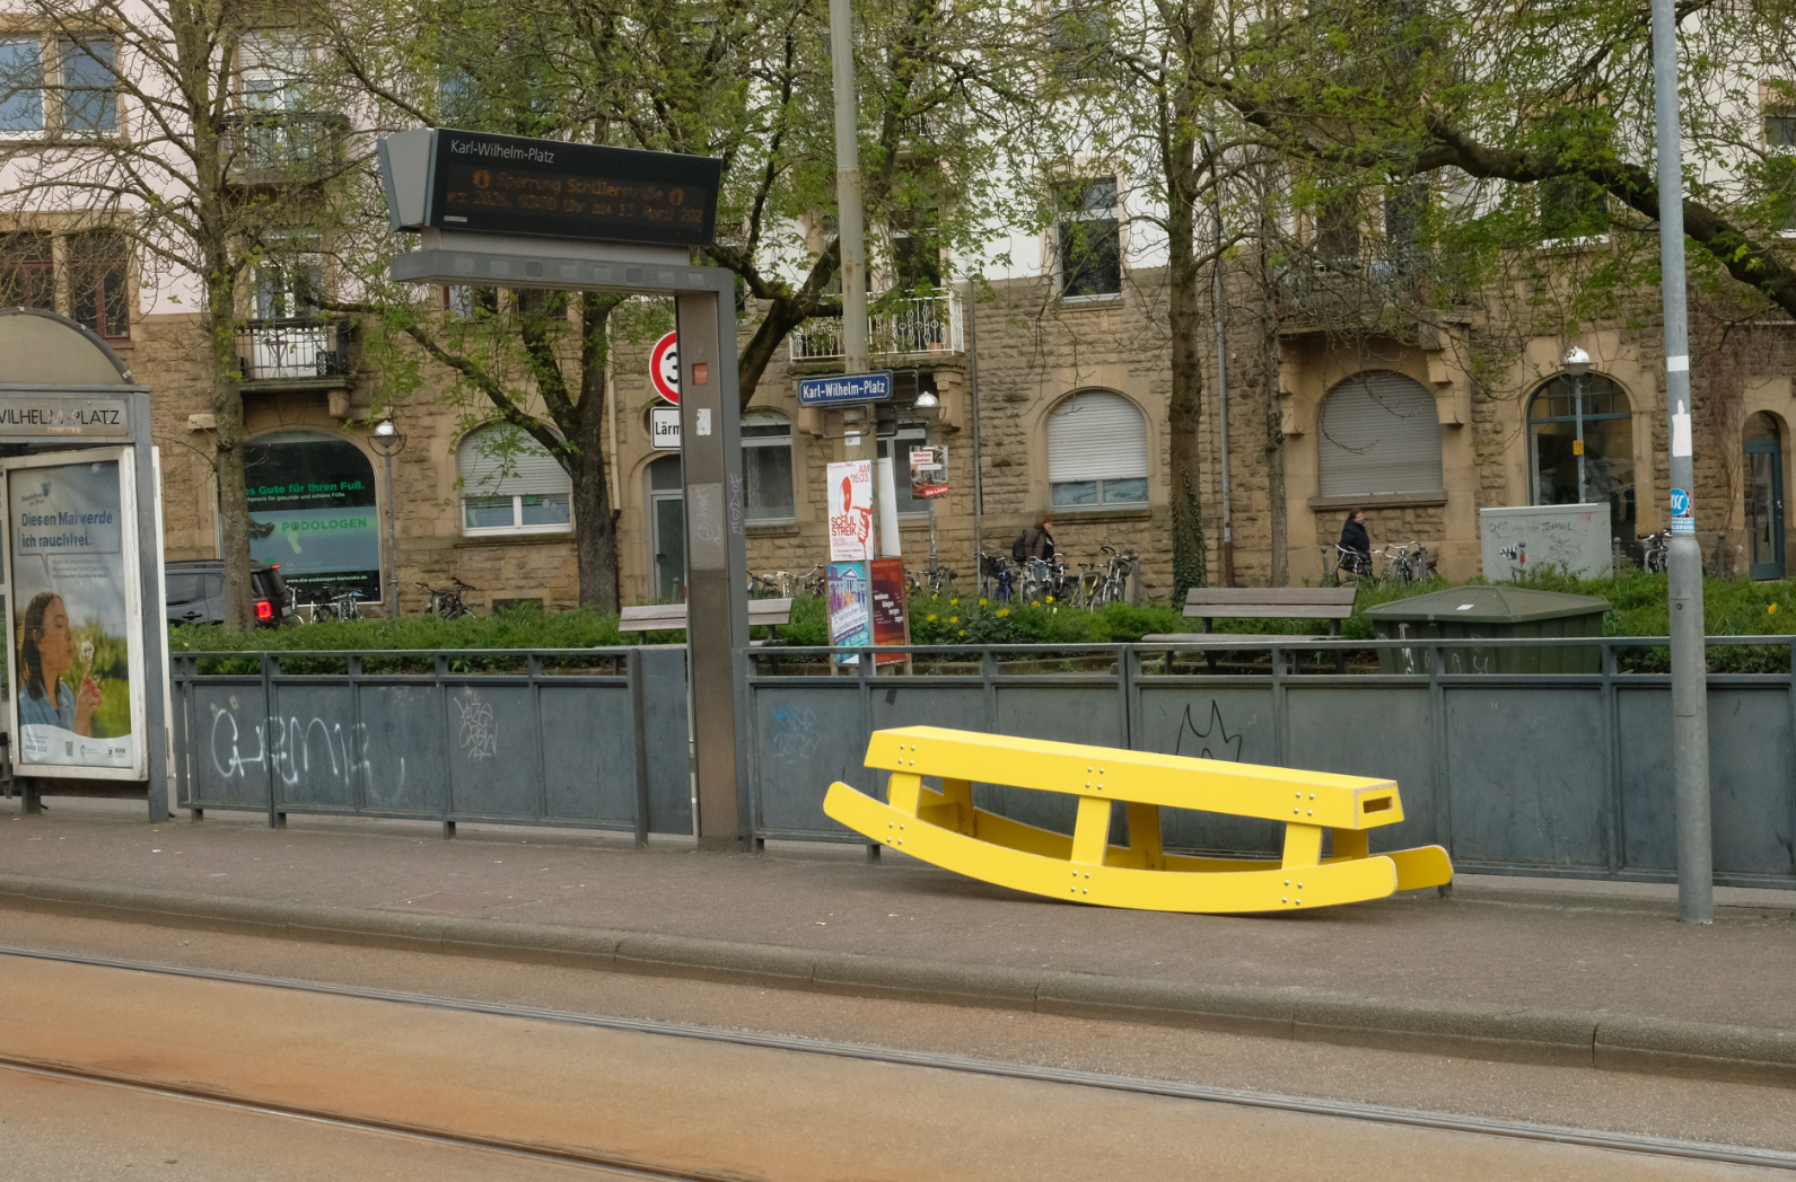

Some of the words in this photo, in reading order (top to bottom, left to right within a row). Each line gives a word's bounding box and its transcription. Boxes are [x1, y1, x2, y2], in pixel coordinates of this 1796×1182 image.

[451, 139, 555, 163] Karl-Wilhelm-Platz
[803, 380, 885, 400] Karl-Wilhelm-Platz
[258, 485, 286, 495] Gute
[288, 483, 305, 493] für
[308, 482, 338, 493] Ihren
[21, 511, 57, 527] Diesen
[58, 511, 79, 526] Mai
[80, 510, 113, 525] werde
[281, 518, 367, 532] PODOLOGEN
[22, 534, 37, 548] ich
[38, 531, 92, 547] rauchfrei.
